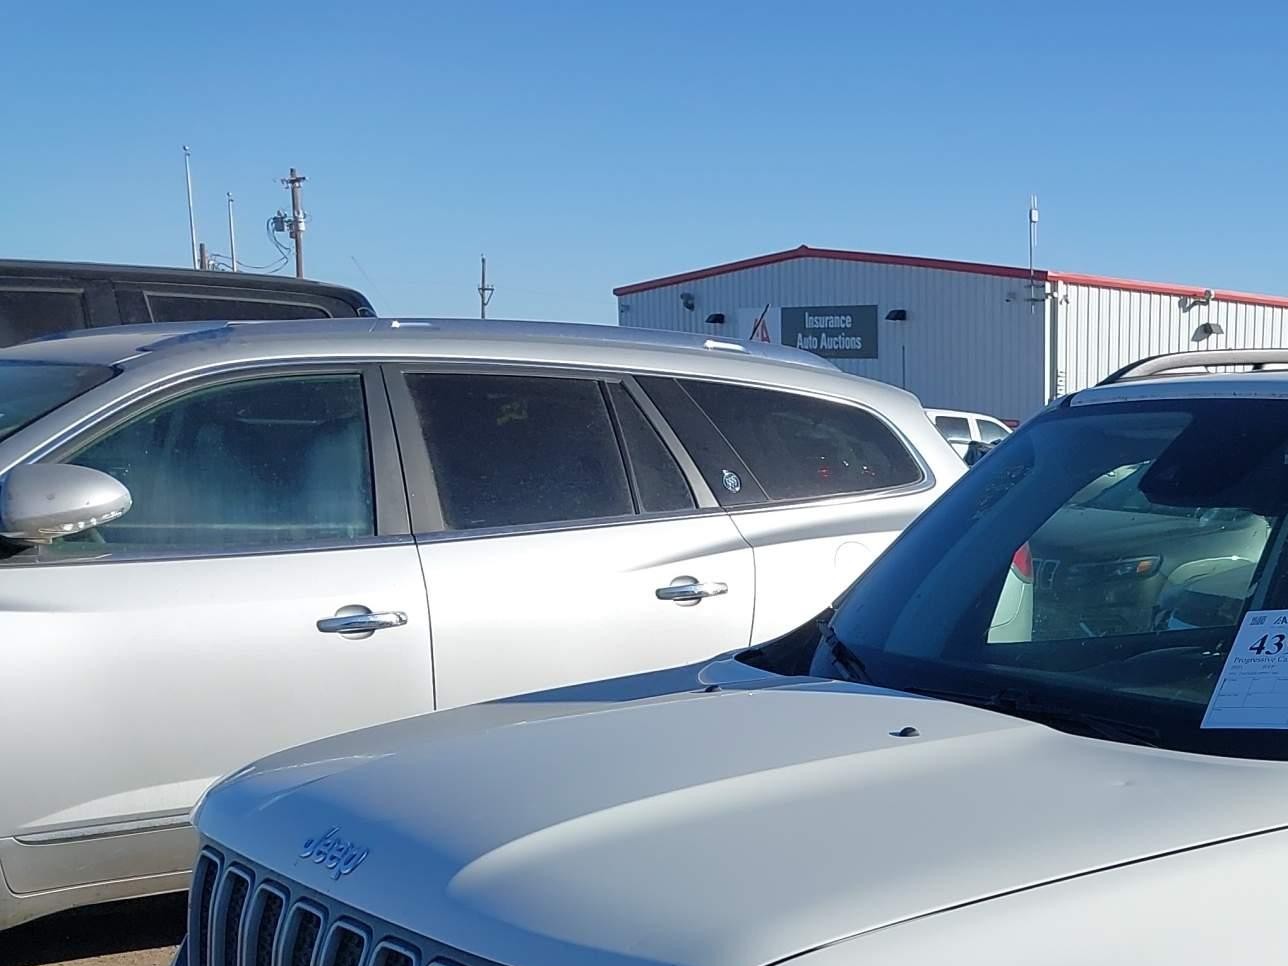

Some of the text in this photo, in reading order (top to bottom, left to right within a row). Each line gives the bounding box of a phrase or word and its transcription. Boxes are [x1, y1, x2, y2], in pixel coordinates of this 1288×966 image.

[805, 311, 852, 329] Insurance
[797, 332, 862, 350] Auto Auctions
[299, 825, 369, 881] Jeep
